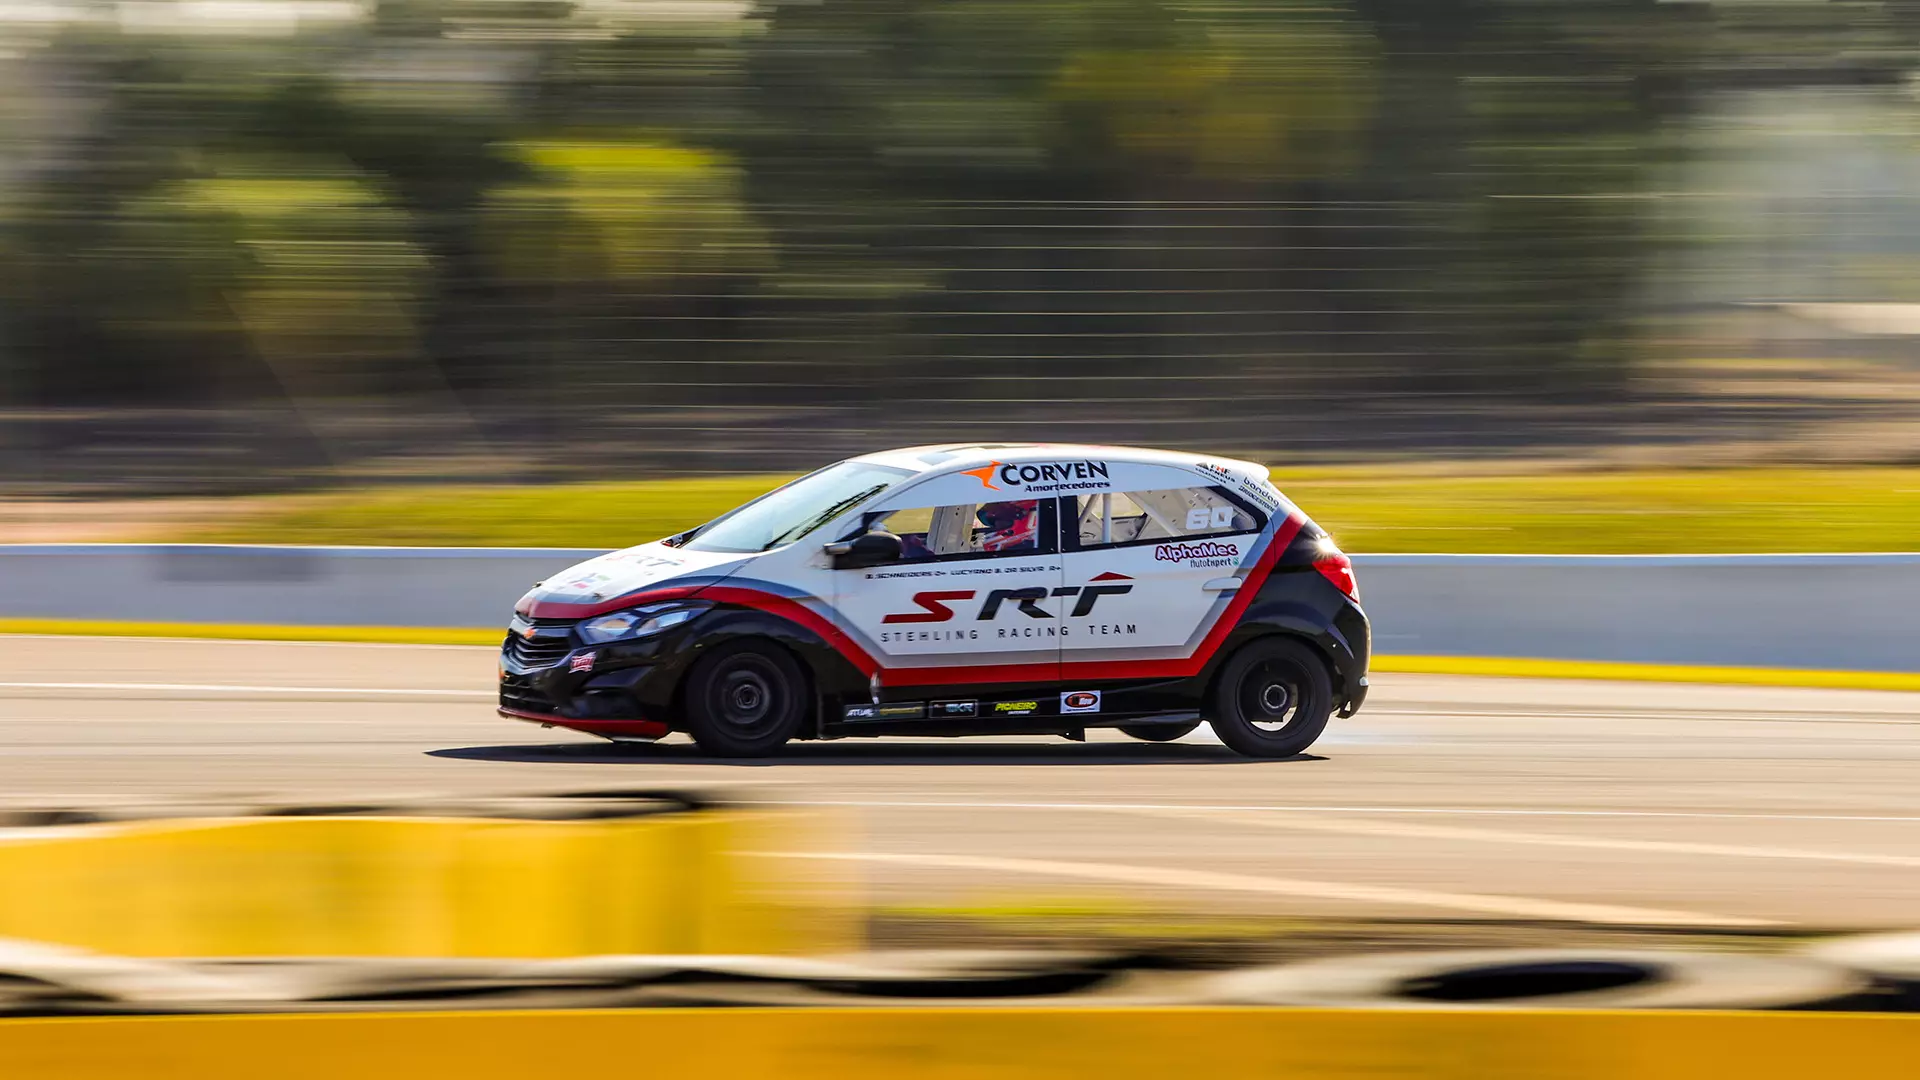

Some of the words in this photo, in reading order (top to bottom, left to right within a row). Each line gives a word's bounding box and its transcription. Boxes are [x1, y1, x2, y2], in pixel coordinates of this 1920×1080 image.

[1000, 459, 1110, 486] CORVEN
[1024, 481, 1111, 493] Amortecedores
[1243, 476, 1280, 508] bandag
[1186, 506, 1234, 530] 60
[1155, 542, 1239, 563] AlphaMec
[880, 583, 1134, 624] SRT
[880, 629, 978, 642] STEHLING
[998, 626, 1069, 638] RACING
[1088, 624, 1136, 635] TEAM
[995, 701, 1038, 711] PIONEIRO
